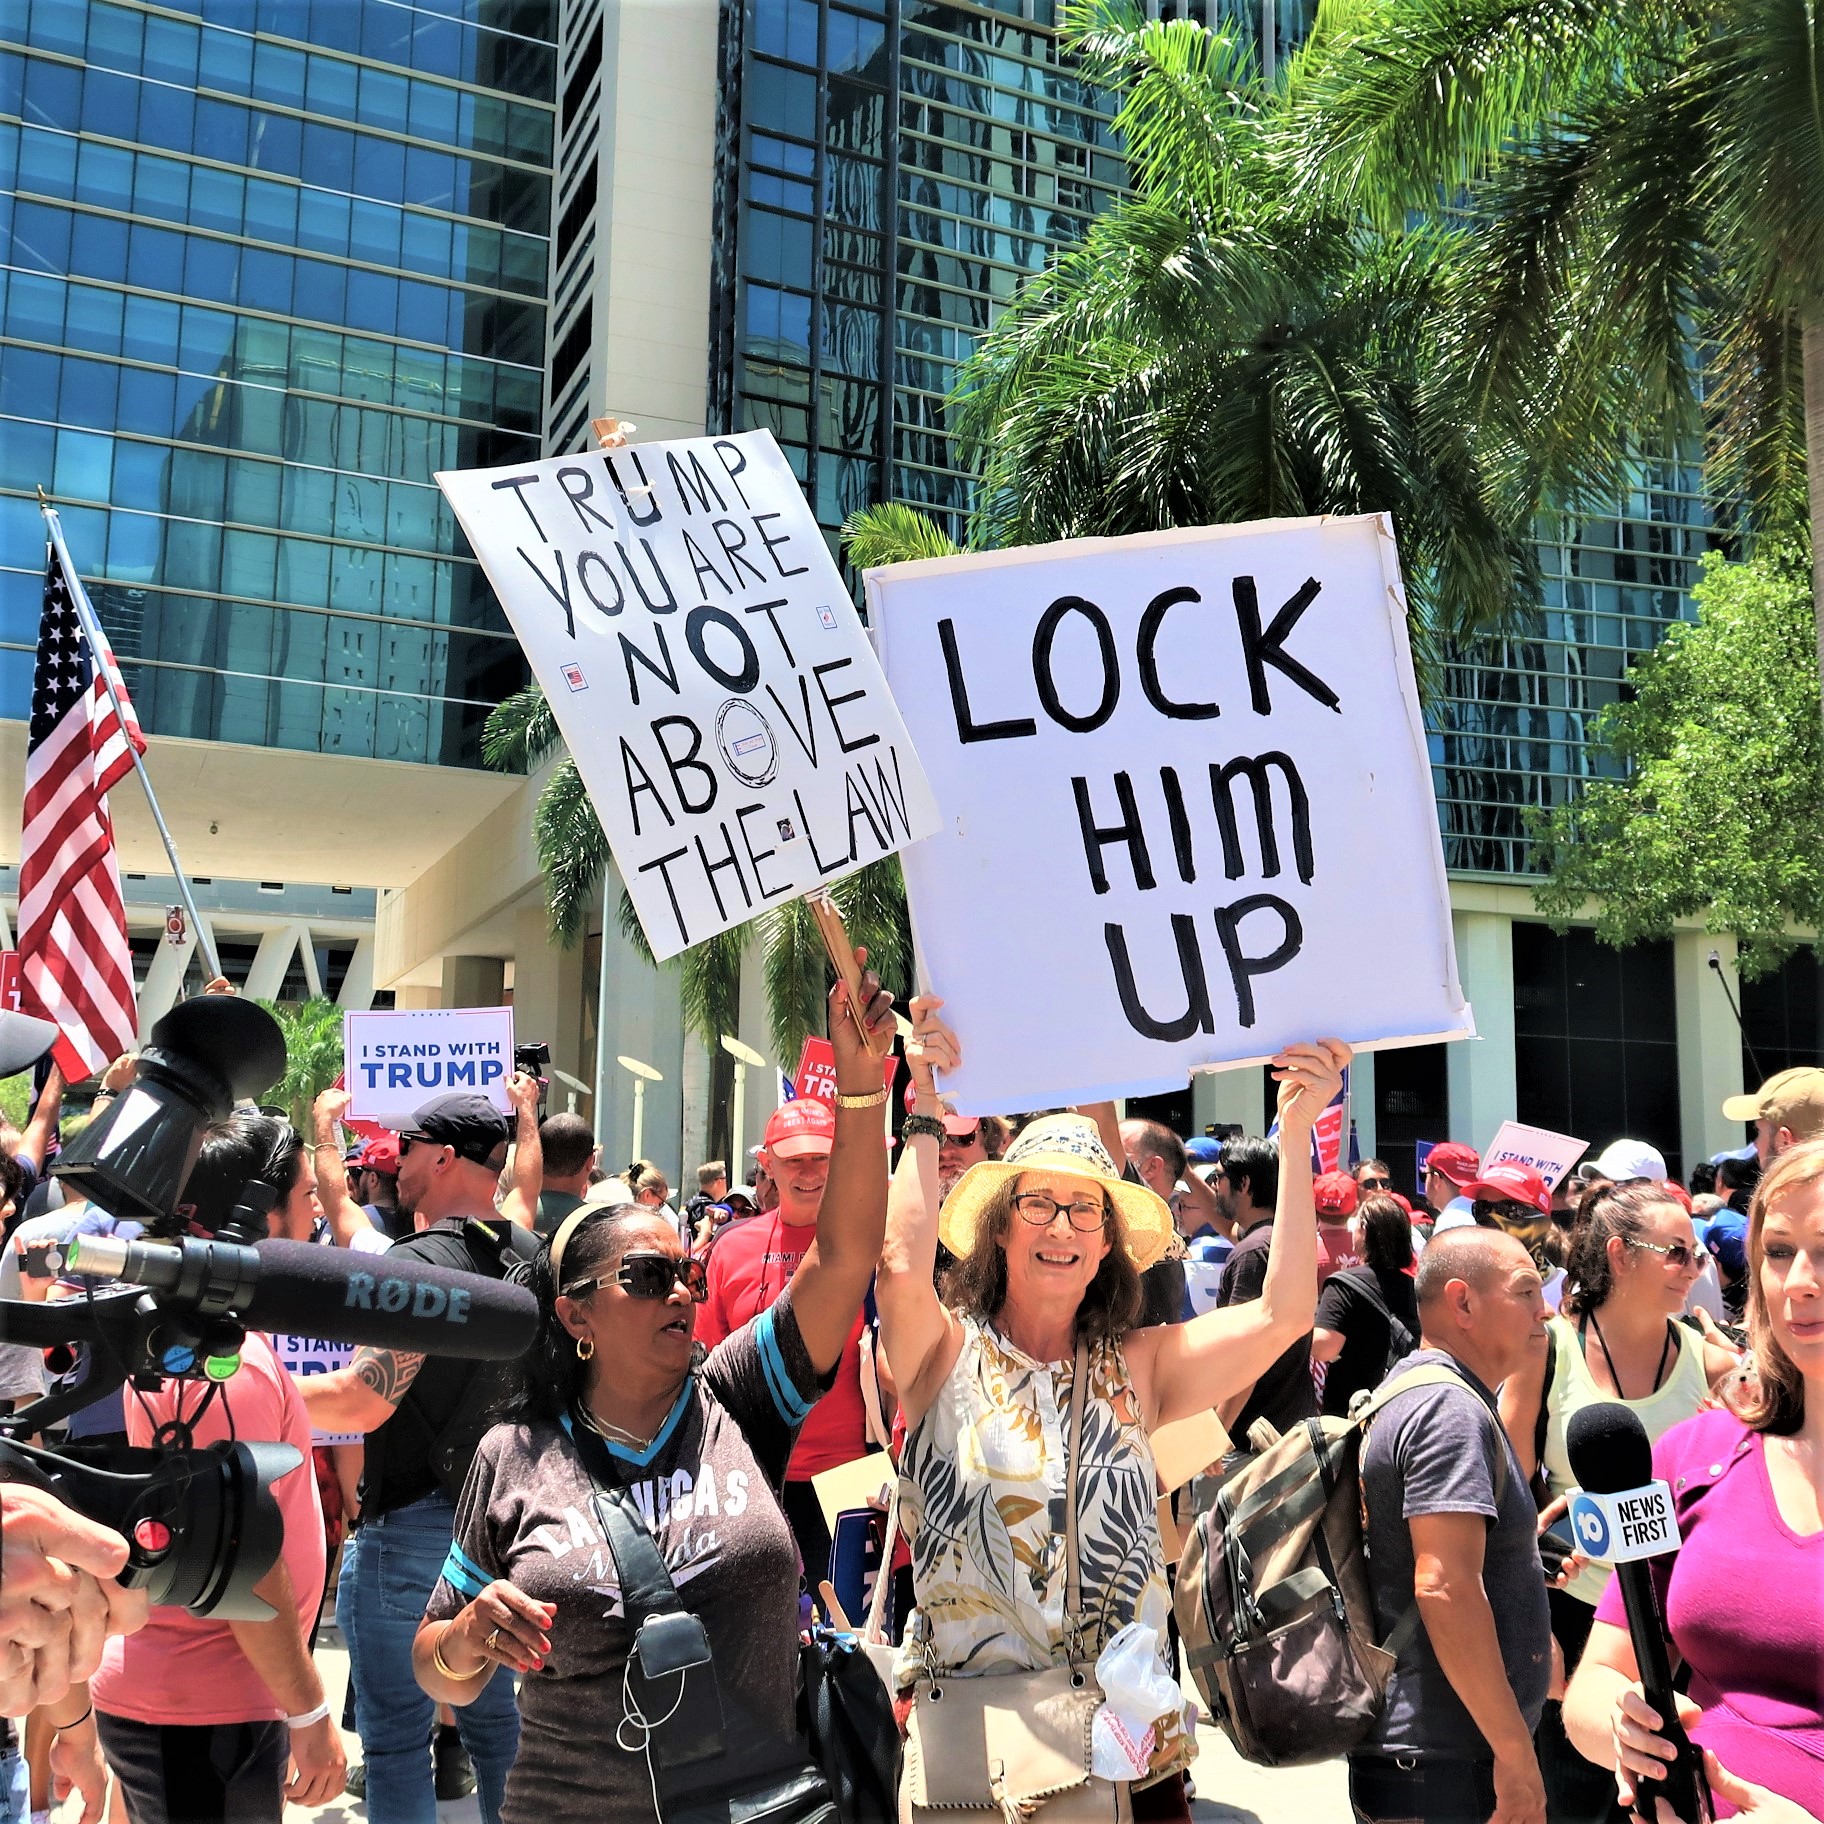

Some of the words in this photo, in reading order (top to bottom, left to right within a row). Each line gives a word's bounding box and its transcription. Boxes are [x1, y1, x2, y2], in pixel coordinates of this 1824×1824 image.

[491, 440, 752, 543] TRUMP
[516, 538, 678, 640] YOU
[682, 512, 809, 600] ARE
[617, 597, 796, 706] NOT
[937, 575, 1343, 745] LOCK
[619, 656, 880, 836] ABOVE
[638, 803, 794, 947] THE
[793, 745, 912, 877] LAW
[1104, 893, 1304, 1043] UP
[363, 1045, 368, 1058] I
[375, 1044, 441, 1058] STAND
[448, 1041, 500, 1056] WITH
[360, 1060, 504, 1089] TRUMP
[808, 1061, 814, 1072] I
[816, 1063, 837, 1078] STA
[783, 1117, 805, 1128] GREAT
[1494, 1150, 1501, 1161] I
[1500, 1152, 1534, 1167] STAND
[1535, 1159, 1564, 1173] WITH
[762, 1251, 796, 1264] MIAMI
[1617, 1493, 1665, 1524] NEWS
[1577, 1511, 1604, 1543] 10
[1622, 1516, 1668, 1548] FIRST
